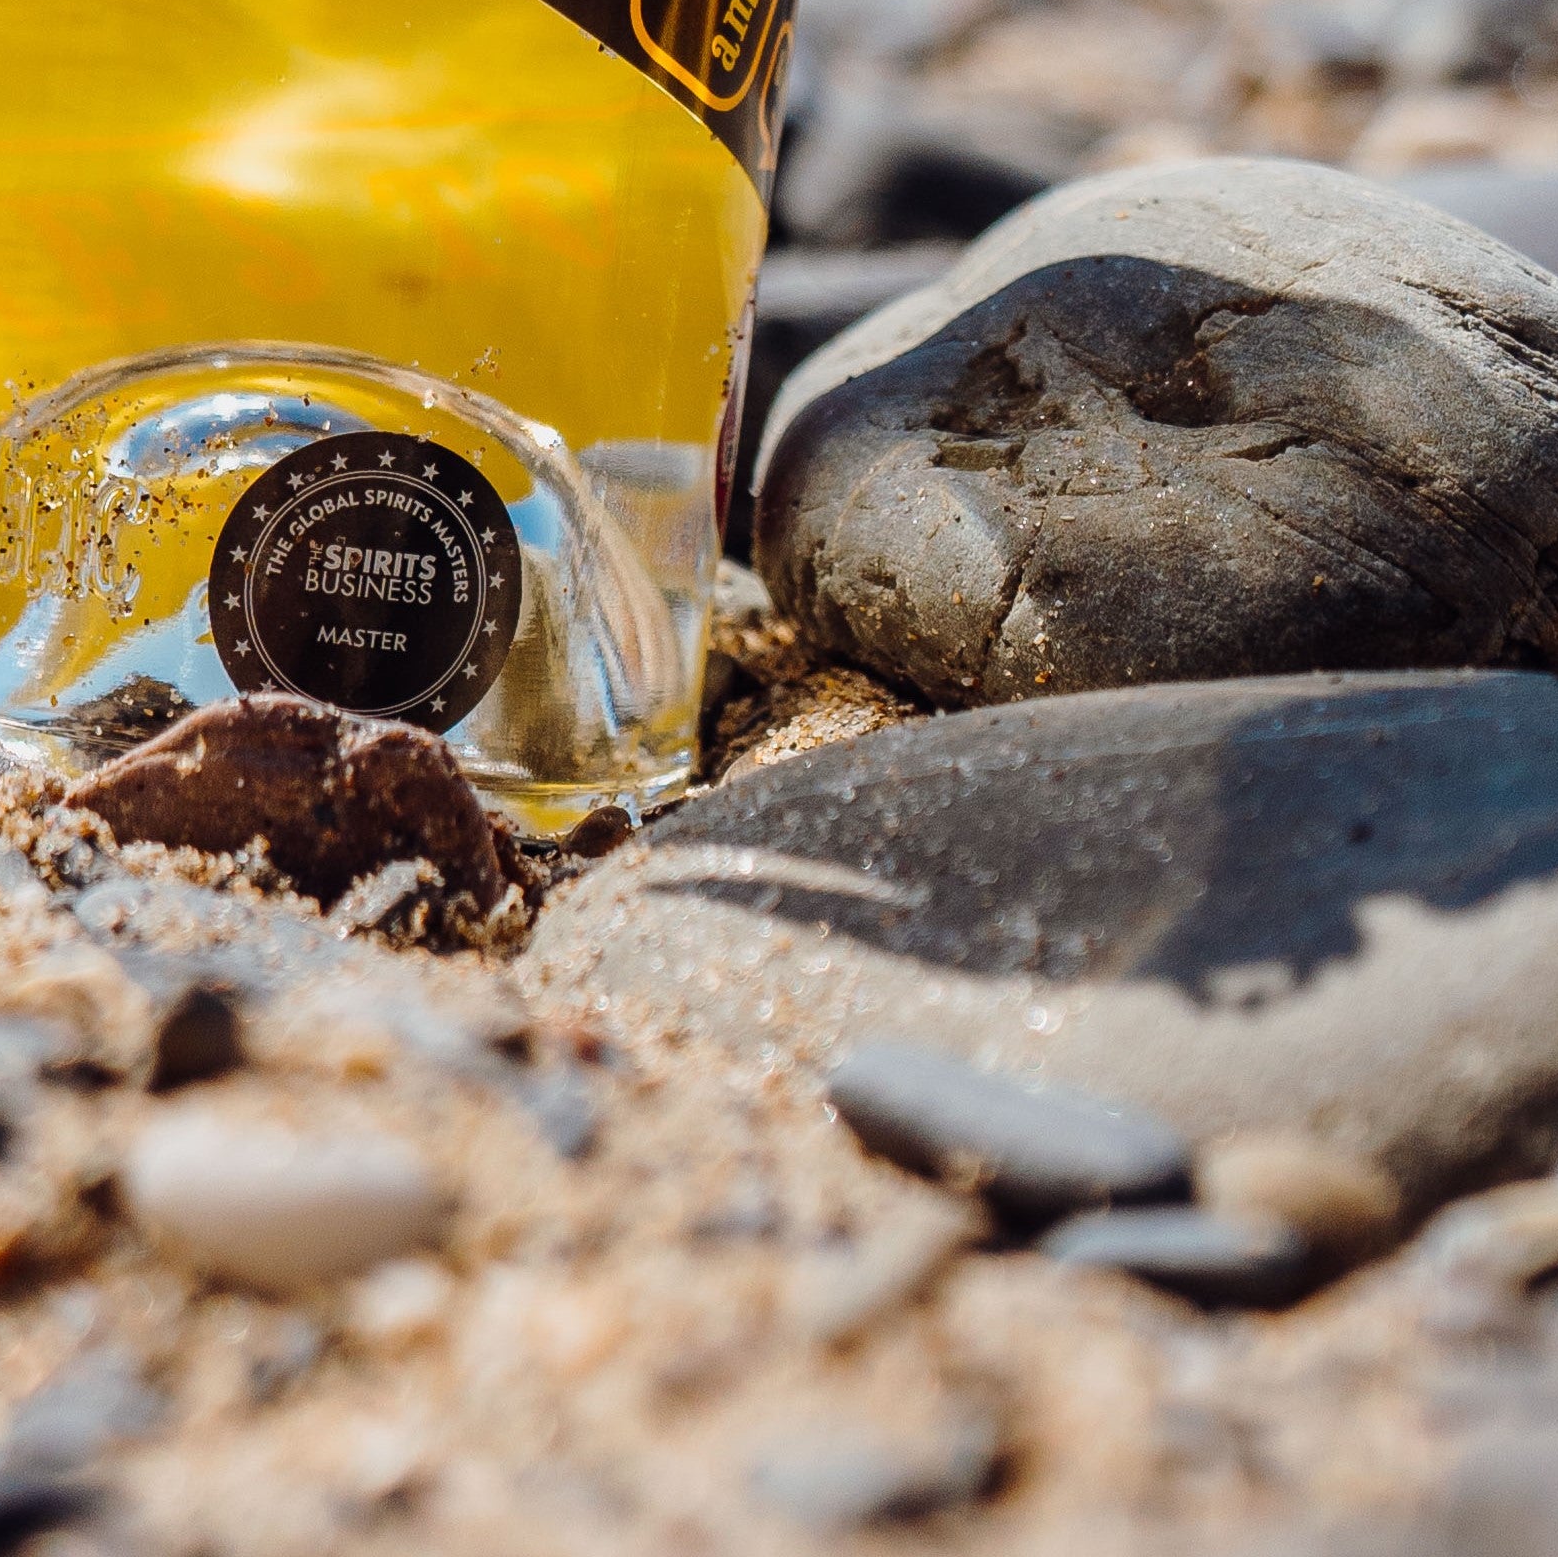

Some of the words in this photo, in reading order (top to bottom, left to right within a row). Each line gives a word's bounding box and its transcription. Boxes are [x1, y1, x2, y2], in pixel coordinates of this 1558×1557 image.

[266, 536, 291, 575] THE
[288, 489, 358, 535] GLOBAL
[363, 488, 432, 521] SPIRITS
[430, 518, 467, 602] MASTERS
[324, 544, 435, 579] SPIRITS
[305, 569, 430, 604] BUSINESS
[315, 625, 406, 651] MASTER
